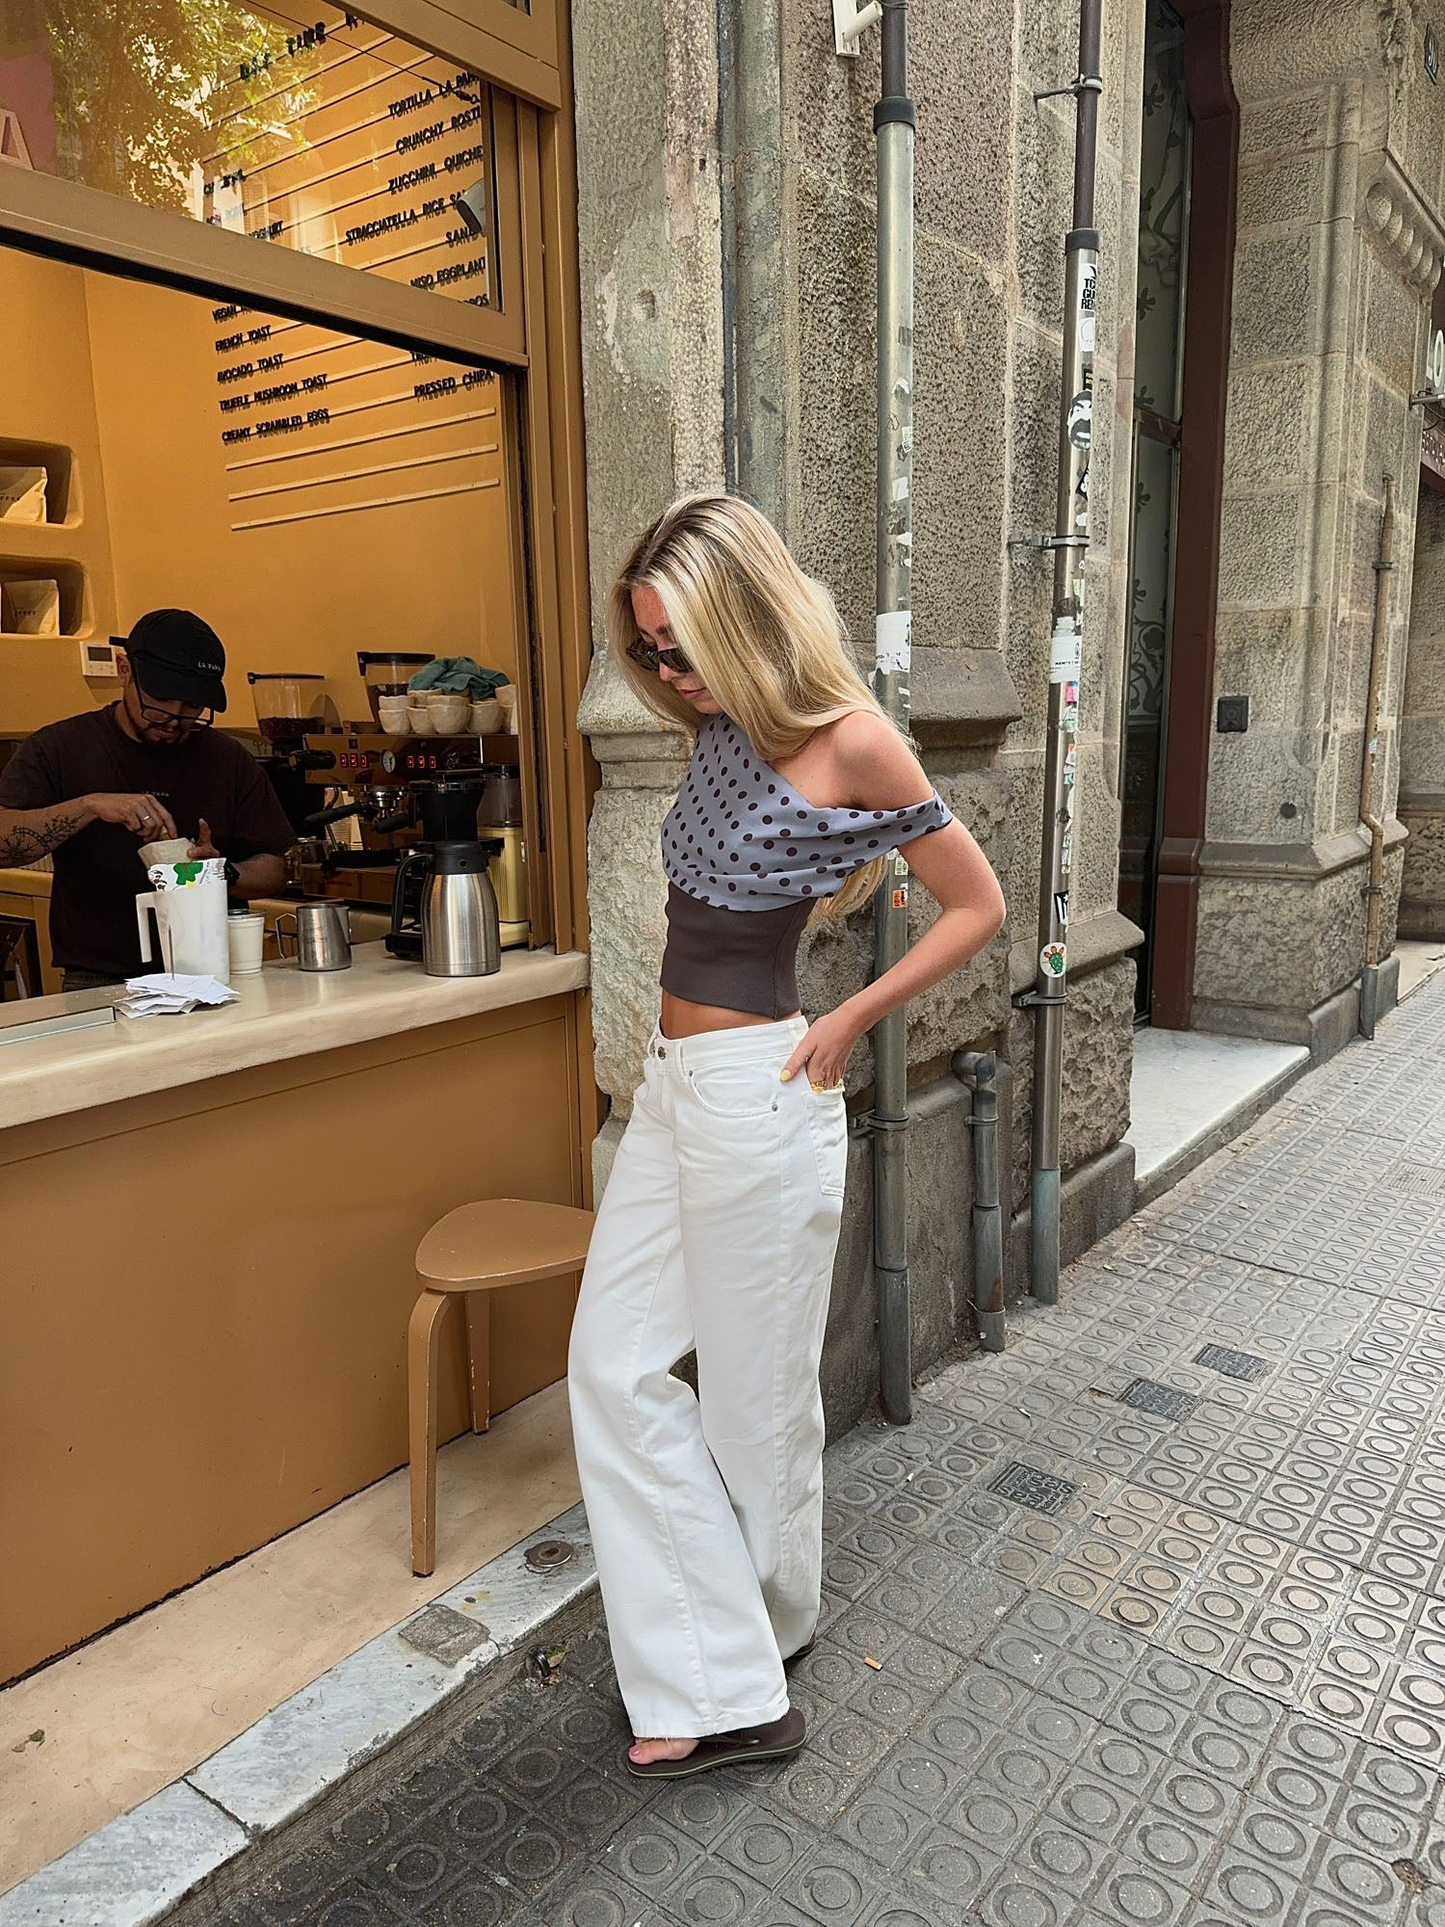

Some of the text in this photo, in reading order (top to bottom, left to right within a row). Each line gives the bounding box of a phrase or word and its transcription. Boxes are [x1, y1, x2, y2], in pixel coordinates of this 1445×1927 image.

[388, 88, 434, 117] TORTILLA
[396, 105, 481, 151] CRUNCHY ROSTI
[388, 145, 484, 191] ZUCCHINI QUICHE
[346, 208, 418, 242] STRACCIATELLA
[422, 197, 446, 216] RICE
[436, 256, 486, 284] EGGPLANT
[215, 325, 271, 352] FRENCH TOAST
[217, 353, 284, 382] AVOCADO TOAST
[413, 369, 493, 398] PRESSED CHIPA
[219, 373, 328, 412] TRUFFLE MUSHROOM TOAST
[221, 408, 330, 444] CREAMY SCRAMBLED EGGS
